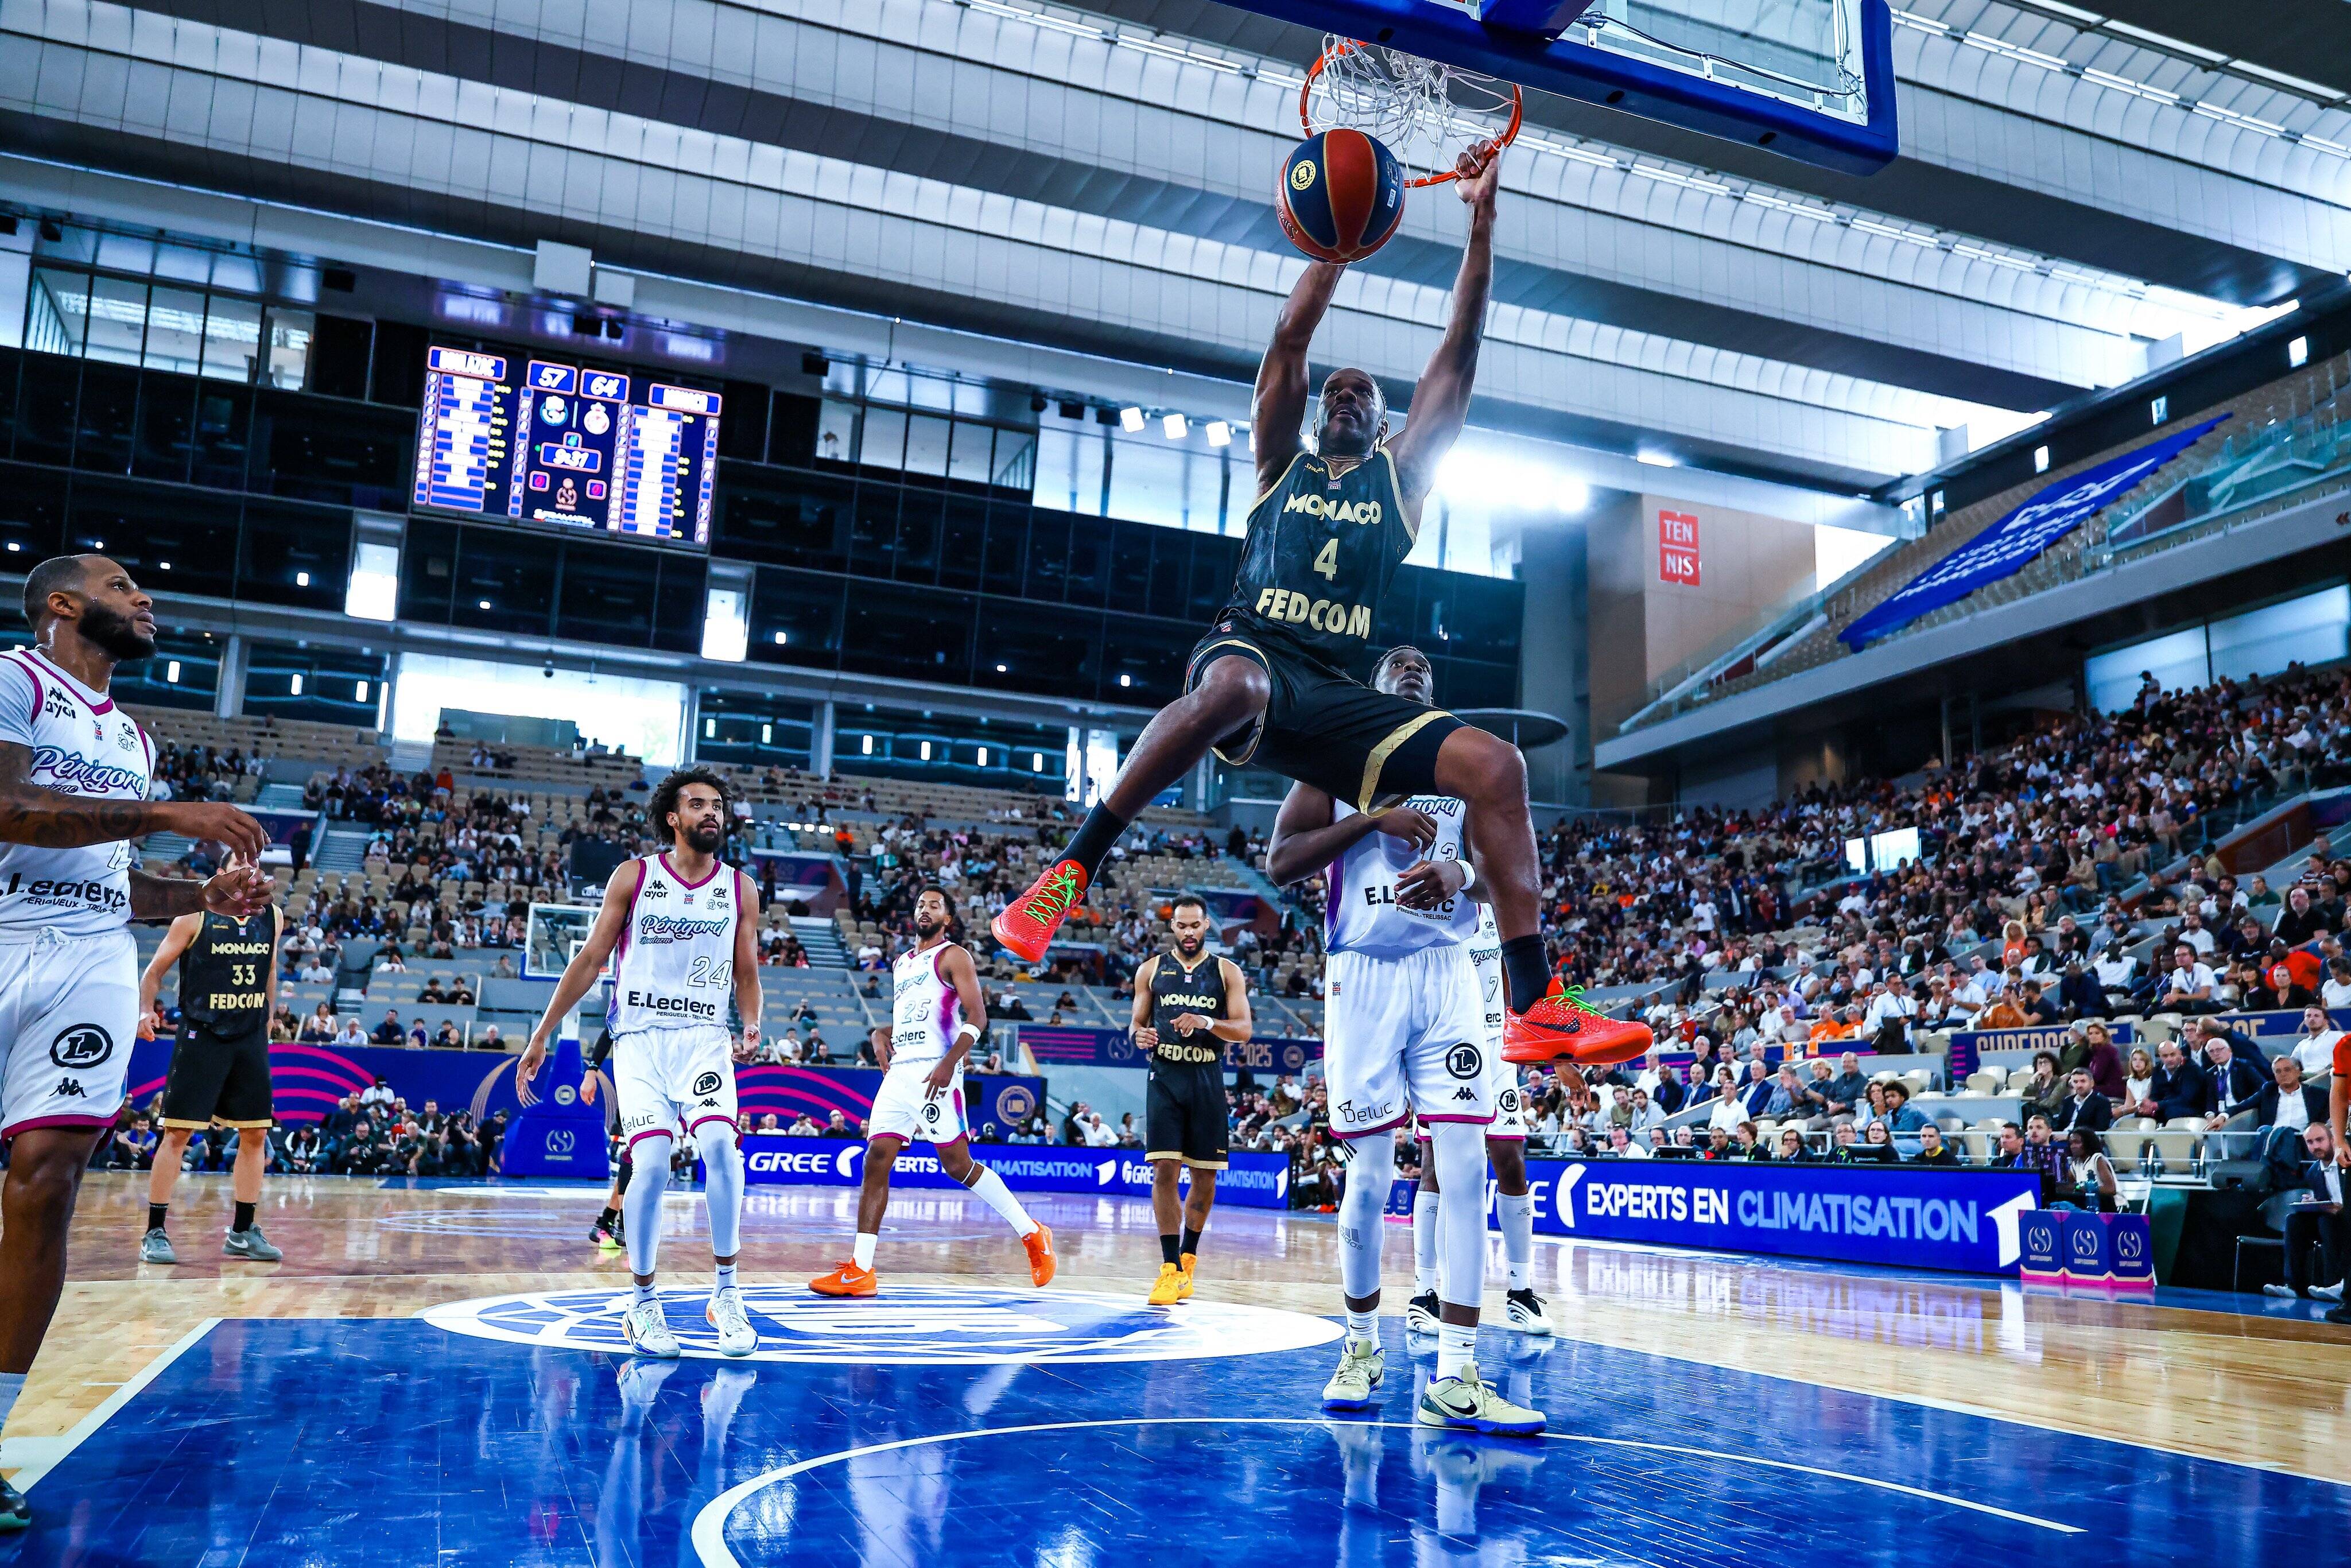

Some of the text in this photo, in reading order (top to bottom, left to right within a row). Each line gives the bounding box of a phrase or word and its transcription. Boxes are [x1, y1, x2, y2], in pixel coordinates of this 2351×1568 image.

[538, 367, 568, 388] 57
[590, 376, 620, 397] 64
[1283, 493, 1382, 525] MONACO
[1664, 519, 1693, 542] TEN
[1314, 538, 1338, 581] 4
[1666, 553, 1694, 576] NIS
[1256, 588, 1371, 639] FEDCOM
[644, 890, 668, 899] ayor
[641, 914, 729, 940] Périgord
[211, 942, 270, 955] MONACO
[639, 936, 673, 944] Boulazac
[231, 964, 256, 985] 33
[687, 956, 732, 990] 24
[1486, 976, 1499, 1002] 7
[628, 991, 715, 1016] E.Leclerc
[901, 999, 932, 1024] 25
[1159, 994, 1217, 1010] MONACO
[1157, 1043, 1216, 1062] FEDCOM
[1344, 1102, 1393, 1122] Deluc
[748, 1152, 832, 1173] GREE
[893, 1156, 938, 1173] ERTS
[974, 1159, 1093, 1178] IMATISATION
[1132, 1164, 1154, 1184] GRE
[1587, 1183, 1688, 1222] EXPERTS
[1693, 1187, 1729, 1225] EN
[1737, 1189, 1978, 1243] CLIMATISATION
